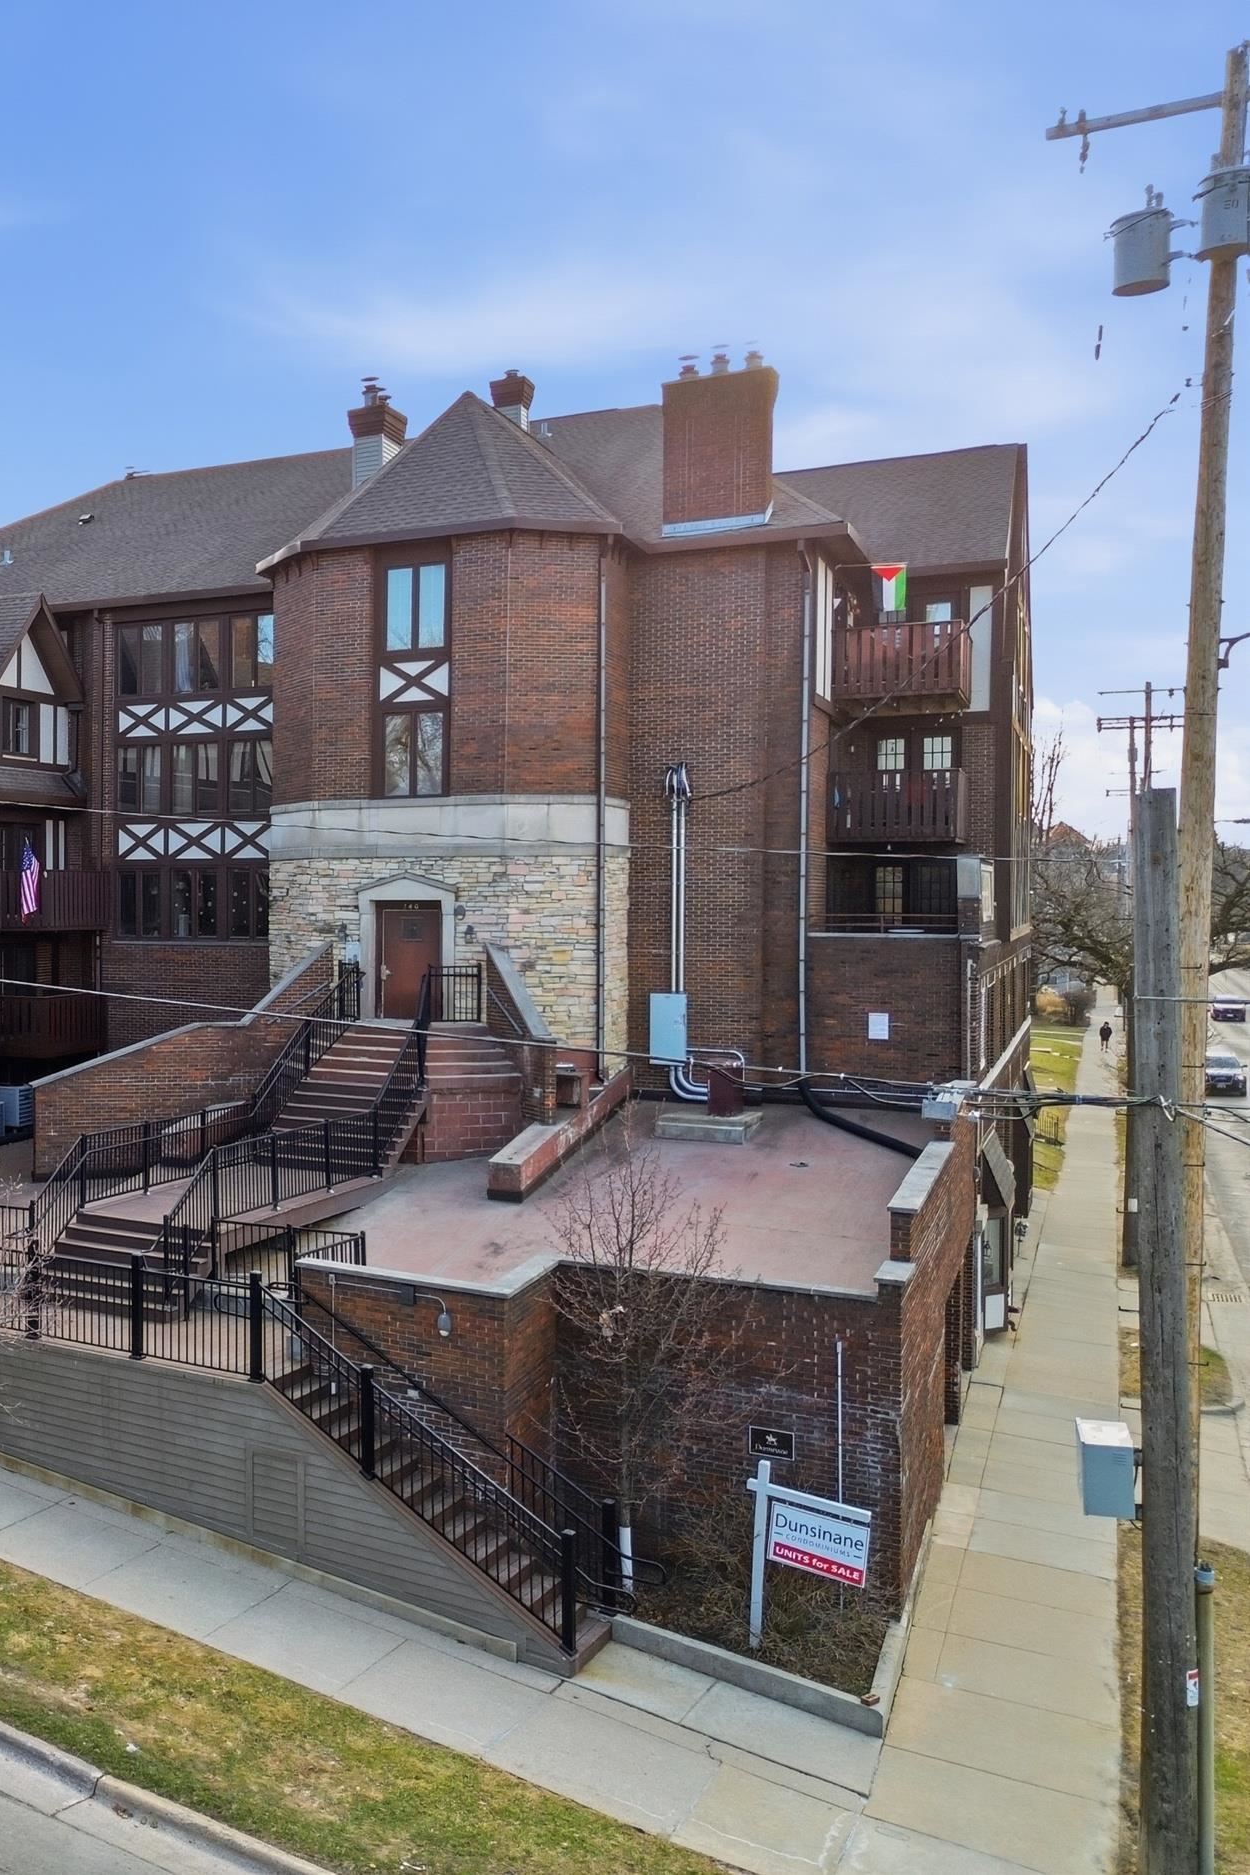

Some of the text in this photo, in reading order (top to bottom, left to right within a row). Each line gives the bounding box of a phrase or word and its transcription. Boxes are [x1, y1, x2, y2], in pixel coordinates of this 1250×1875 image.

[775, 1513, 864, 1551] Dunsinane
[785, 1533, 850, 1558] CONDOMINIUMS
[775, 1545, 861, 1581] UNITS for SALE
